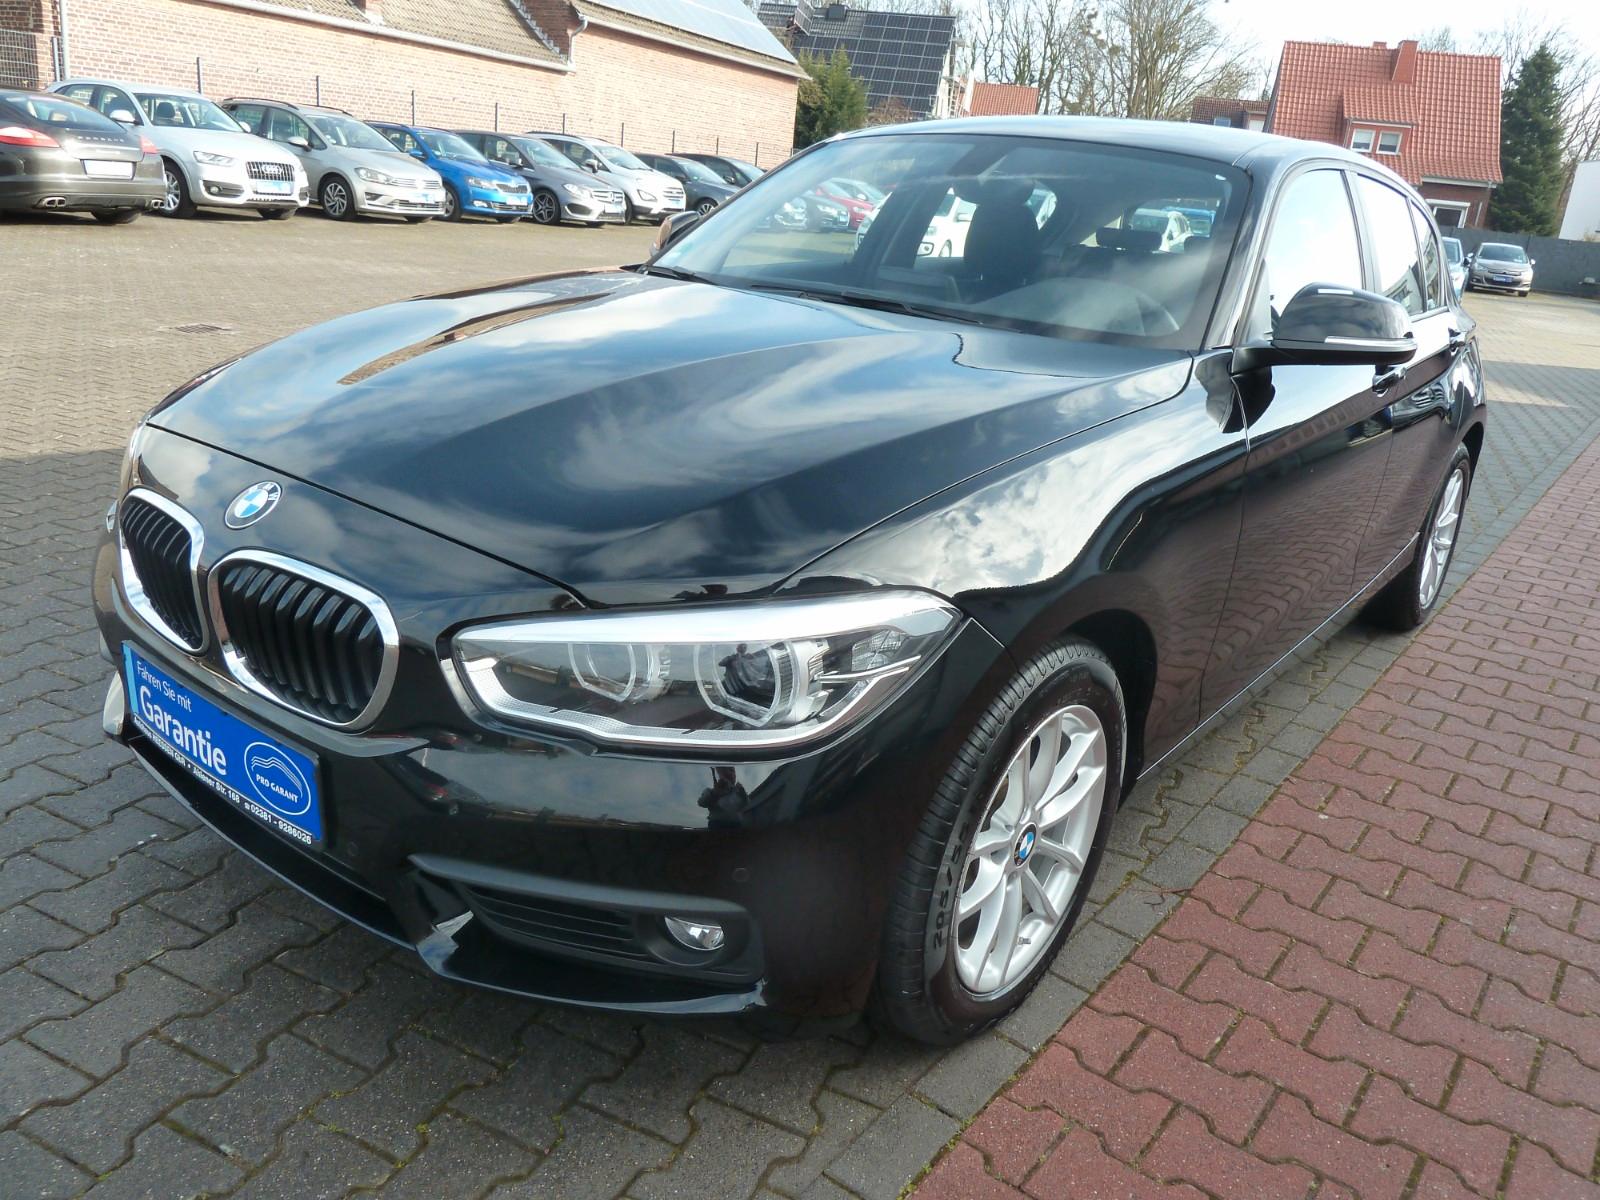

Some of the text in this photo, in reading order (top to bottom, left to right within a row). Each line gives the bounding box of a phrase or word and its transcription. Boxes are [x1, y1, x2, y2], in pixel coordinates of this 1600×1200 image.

[136, 660, 193, 713] Fahren Sie mit
[139, 684, 228, 776] Garantie
[255, 773, 299, 803] PRO GARANT
